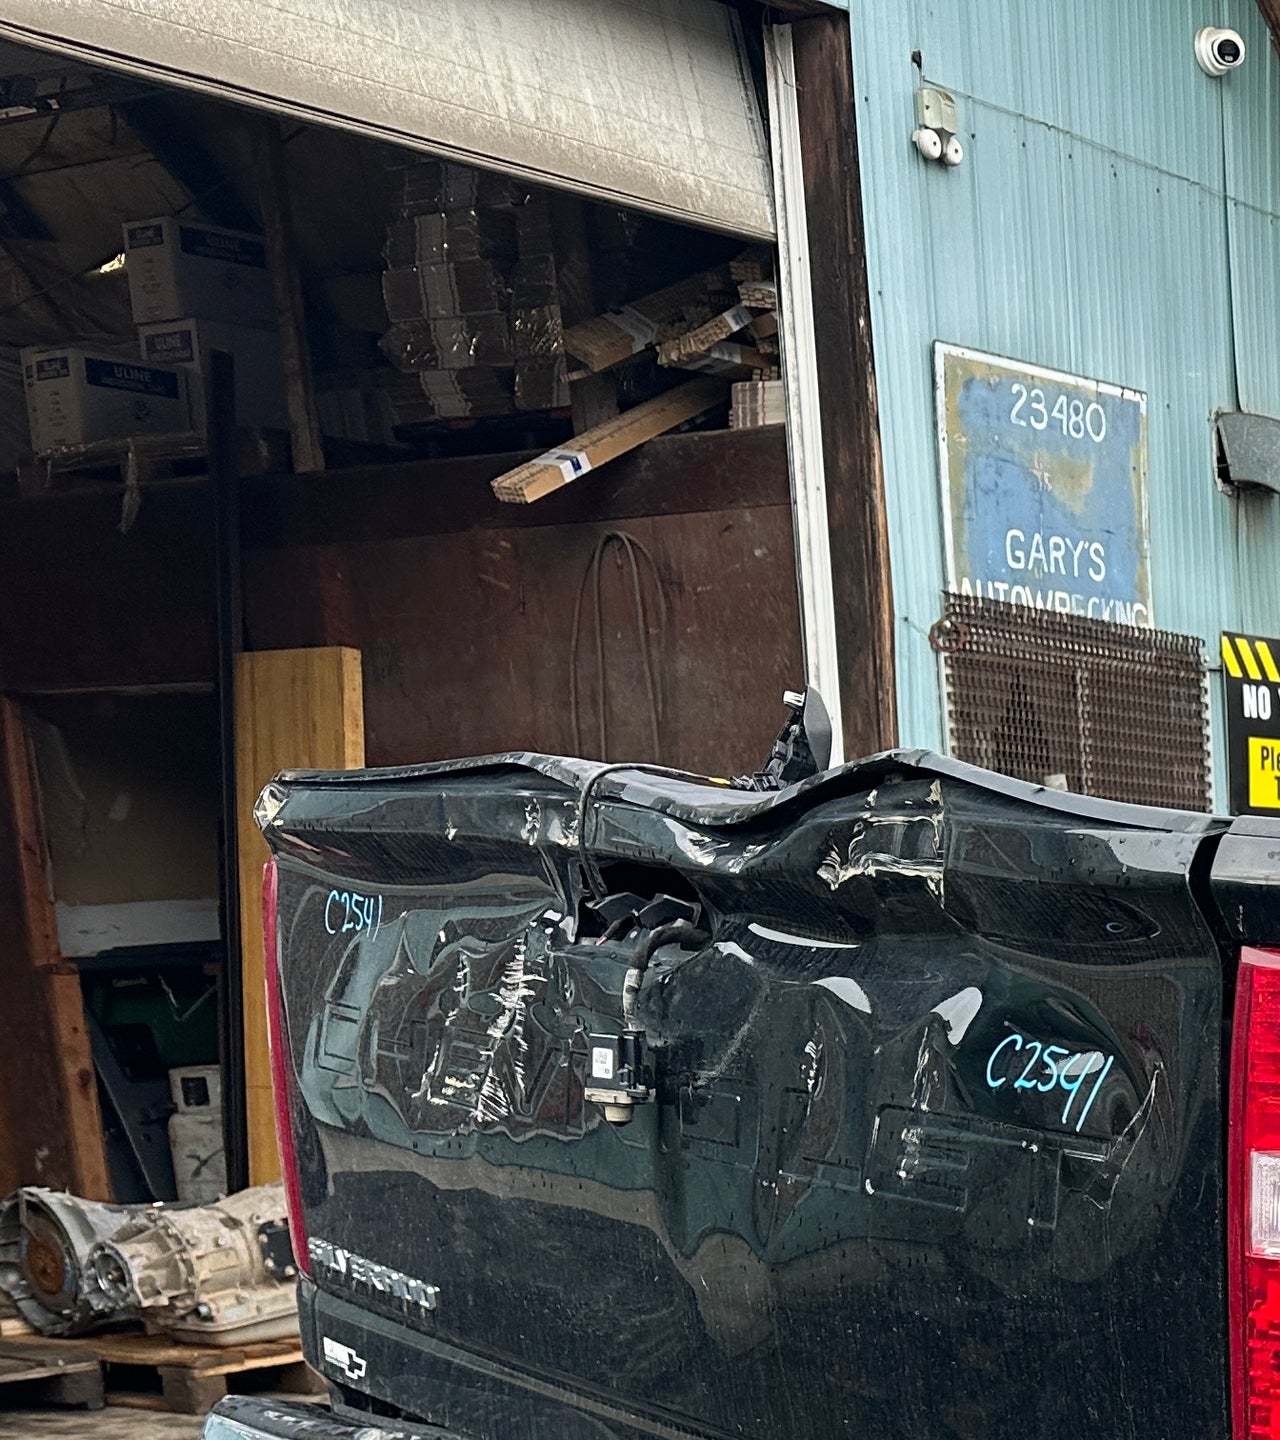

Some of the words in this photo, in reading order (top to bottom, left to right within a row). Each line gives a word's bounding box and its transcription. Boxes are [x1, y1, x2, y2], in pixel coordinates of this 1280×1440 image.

[113, 364, 151, 383] ULINE
[1010, 383, 1107, 443] 23480
[1005, 529, 1106, 582] GARY'S
[1242, 683, 1272, 720] NO
[325, 889, 383, 943] C2541
[986, 1033, 1114, 1132] C2541
